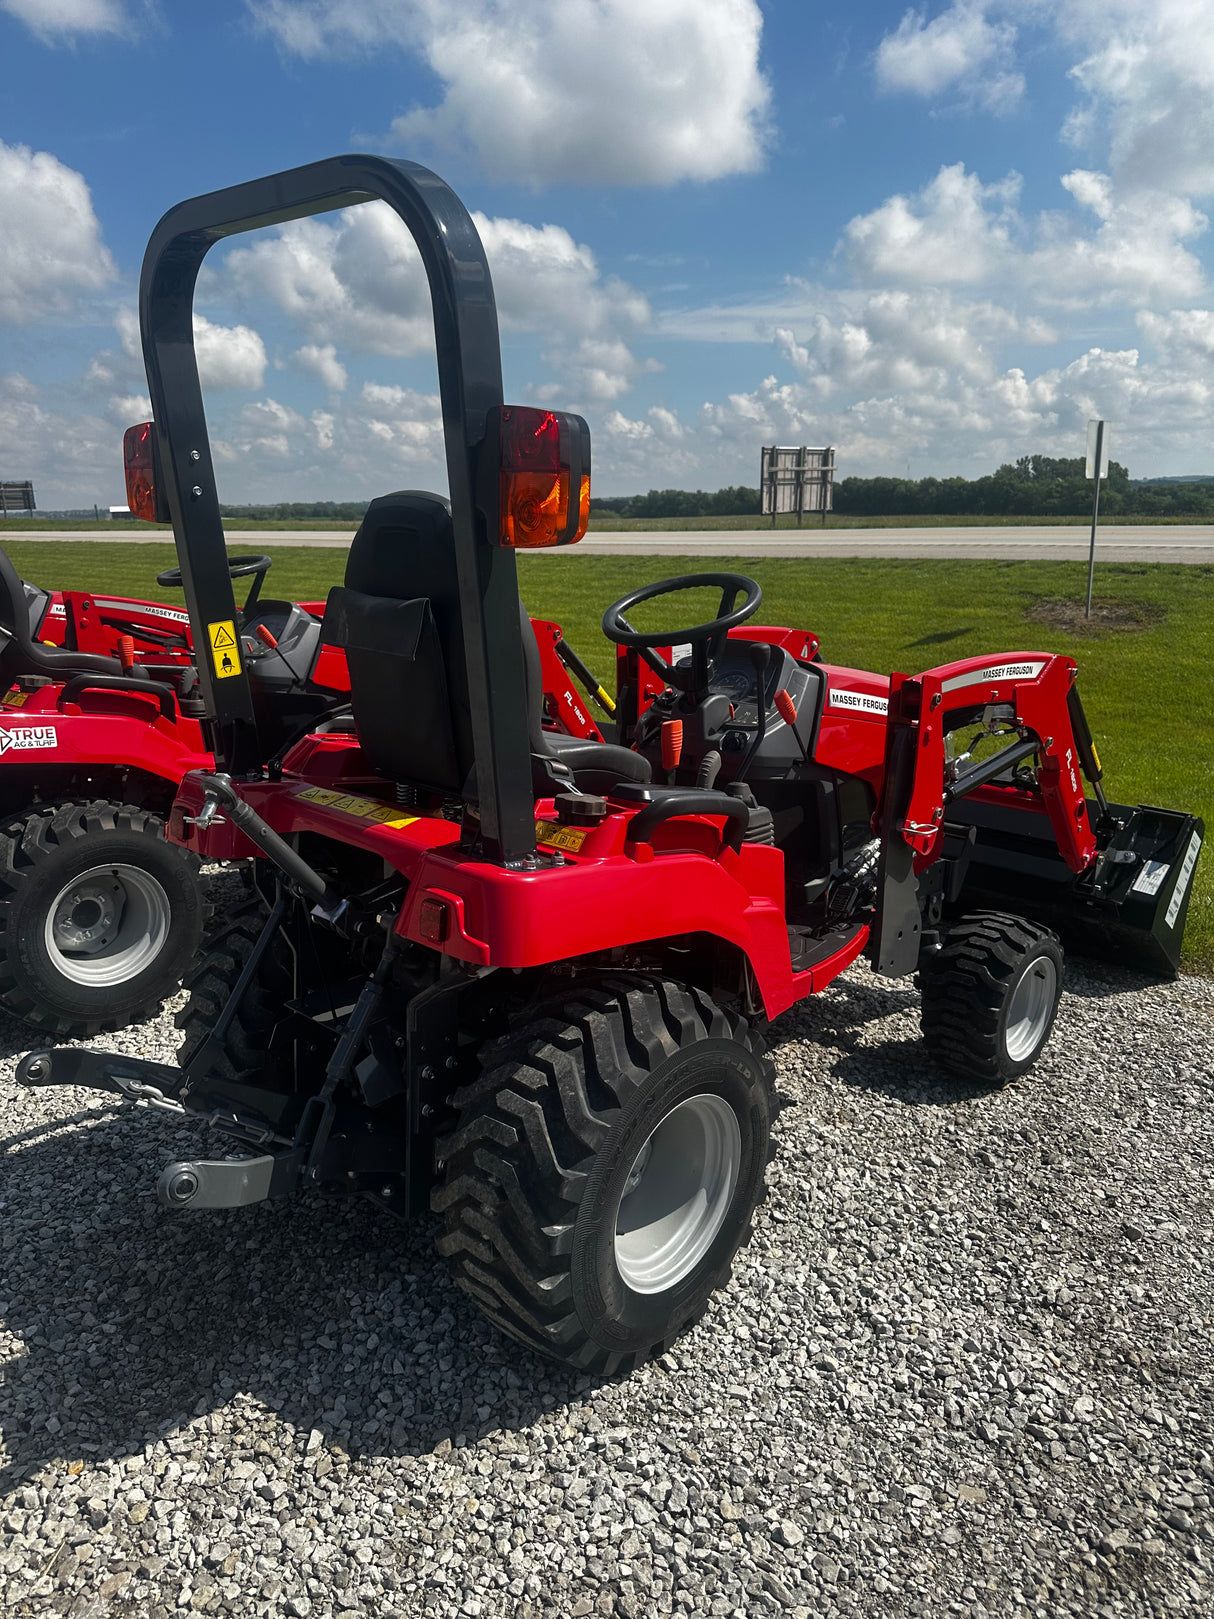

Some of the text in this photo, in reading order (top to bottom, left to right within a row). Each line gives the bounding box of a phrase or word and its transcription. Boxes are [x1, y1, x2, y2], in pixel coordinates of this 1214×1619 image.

[145, 607, 189, 621] MASSEY FERG
[982, 665, 1033, 679] MASSEY FERGUSON
[564, 690, 573, 707] FL
[832, 693, 889, 712] MASSEY FERGUS
[12, 728, 55, 740] TRUE
[14, 740, 27, 748] AG
[34, 739, 56, 747] TURF
